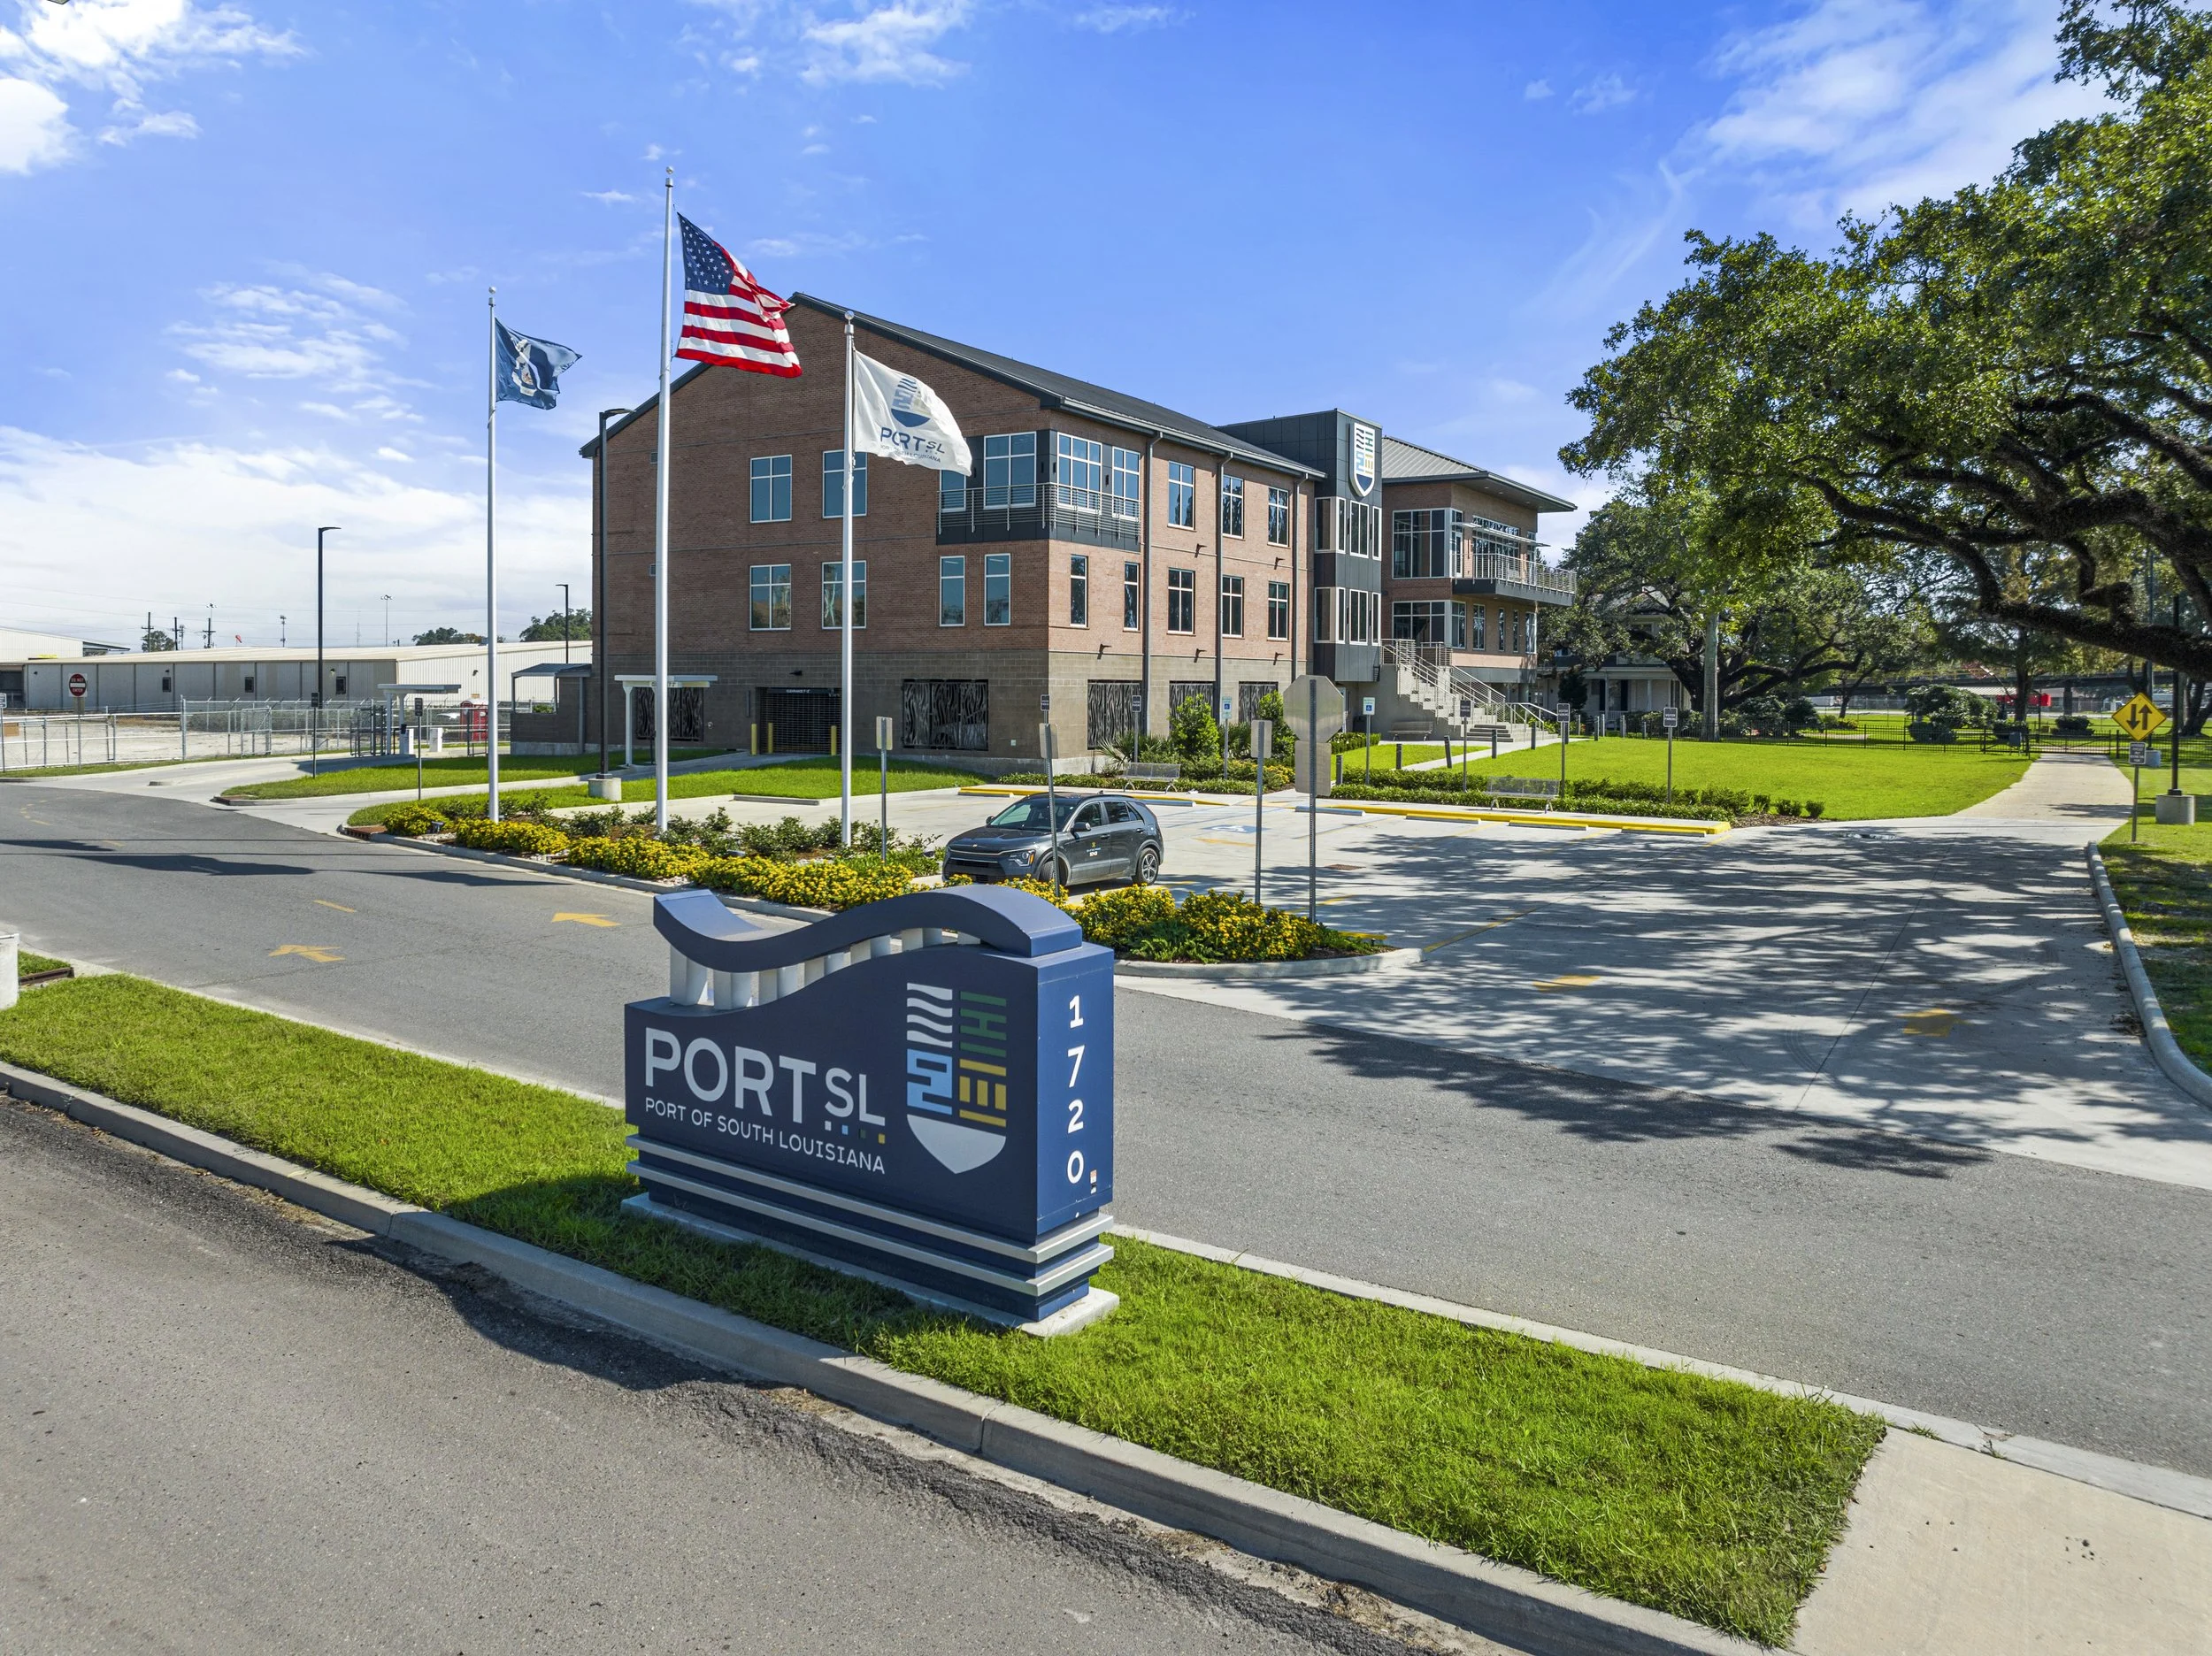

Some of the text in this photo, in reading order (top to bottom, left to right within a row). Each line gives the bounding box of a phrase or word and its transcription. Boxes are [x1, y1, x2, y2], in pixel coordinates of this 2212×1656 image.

[645, 1027, 886, 1126] PORT SL
[1066, 995, 1085, 1184] 1720
[645, 1097, 885, 1174] PORT OF SOUTH LOUISIANA
